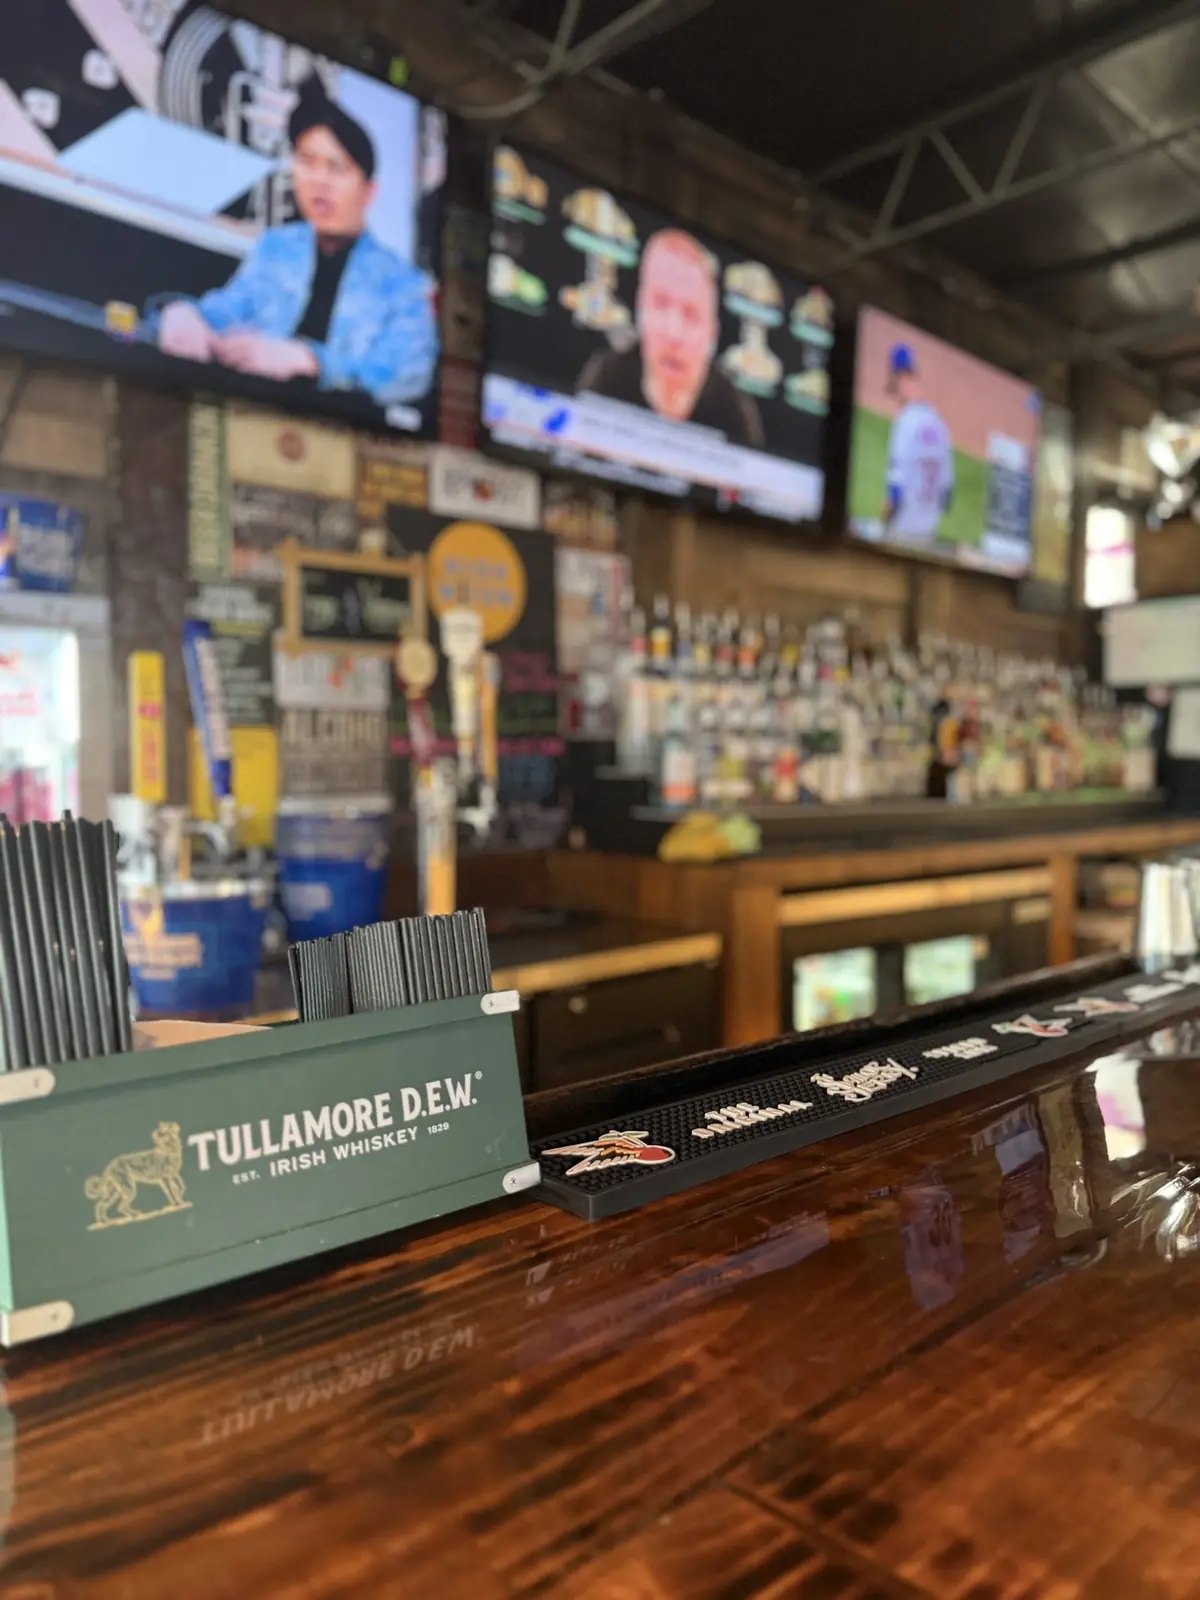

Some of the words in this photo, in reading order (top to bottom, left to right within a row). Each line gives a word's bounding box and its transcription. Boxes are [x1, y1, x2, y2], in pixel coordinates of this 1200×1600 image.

[187, 1092, 393, 1171] TULLAMORE
[232, 1170, 260, 1185] EST.
[270, 1150, 326, 1177] IRISH
[333, 1126, 418, 1160] WHISKEY
[427, 1122, 450, 1135] 1829
